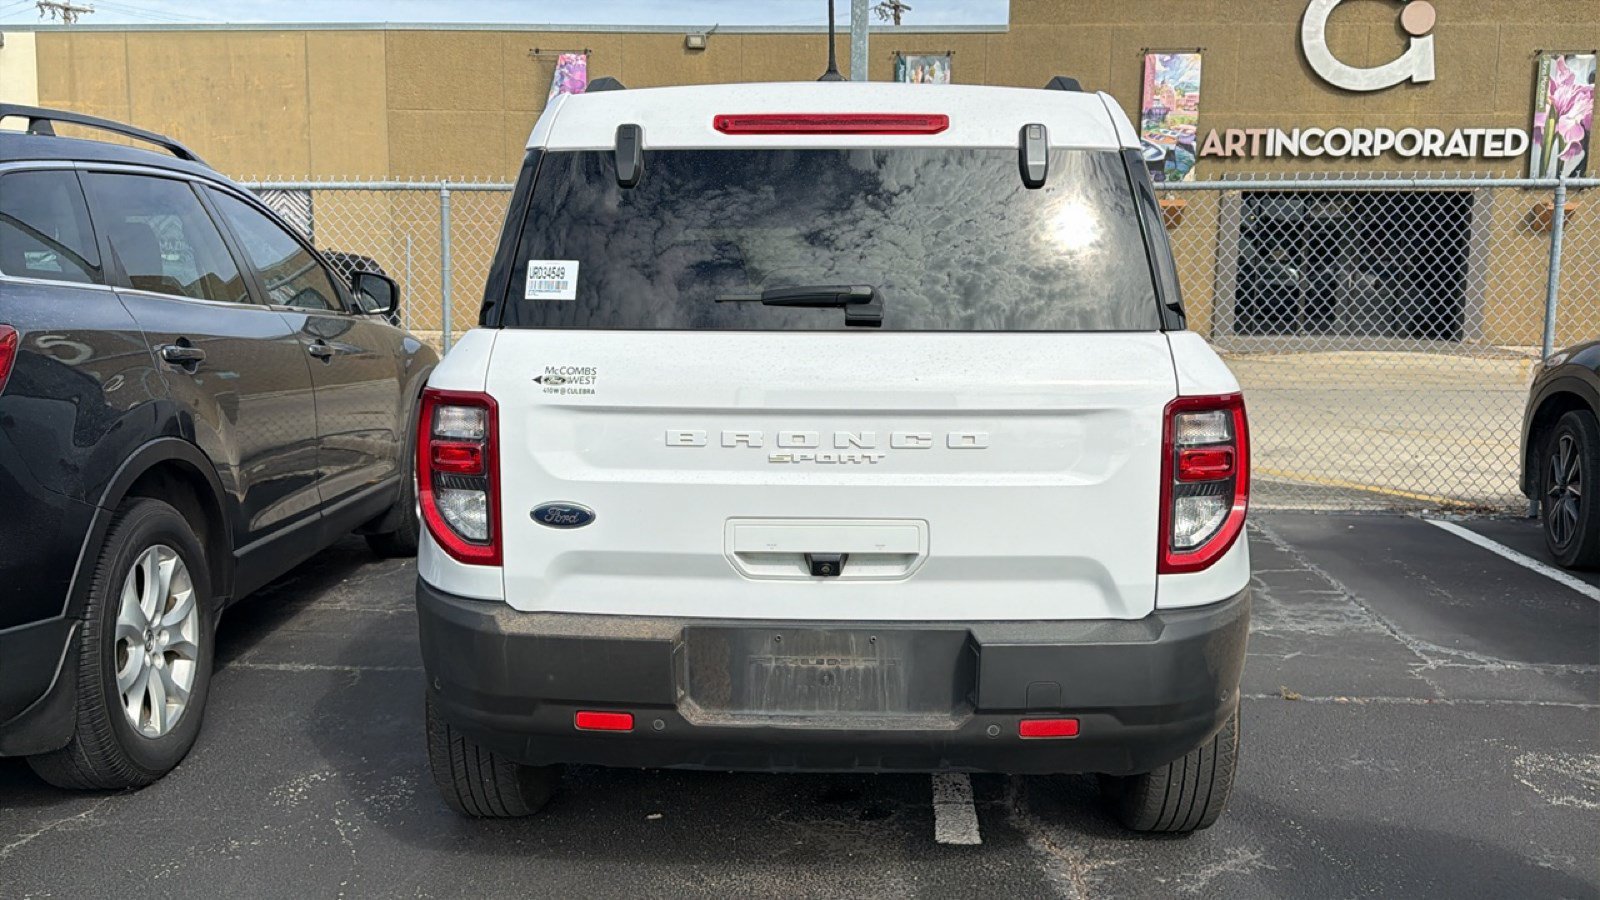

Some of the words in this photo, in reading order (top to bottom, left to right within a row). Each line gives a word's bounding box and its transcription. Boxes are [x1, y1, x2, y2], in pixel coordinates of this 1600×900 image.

[545, 366, 597, 375] McCOMBS
[567, 375, 597, 385] WEST
[665, 429, 990, 450] BRONCO
[768, 453, 886, 465] SPORT
